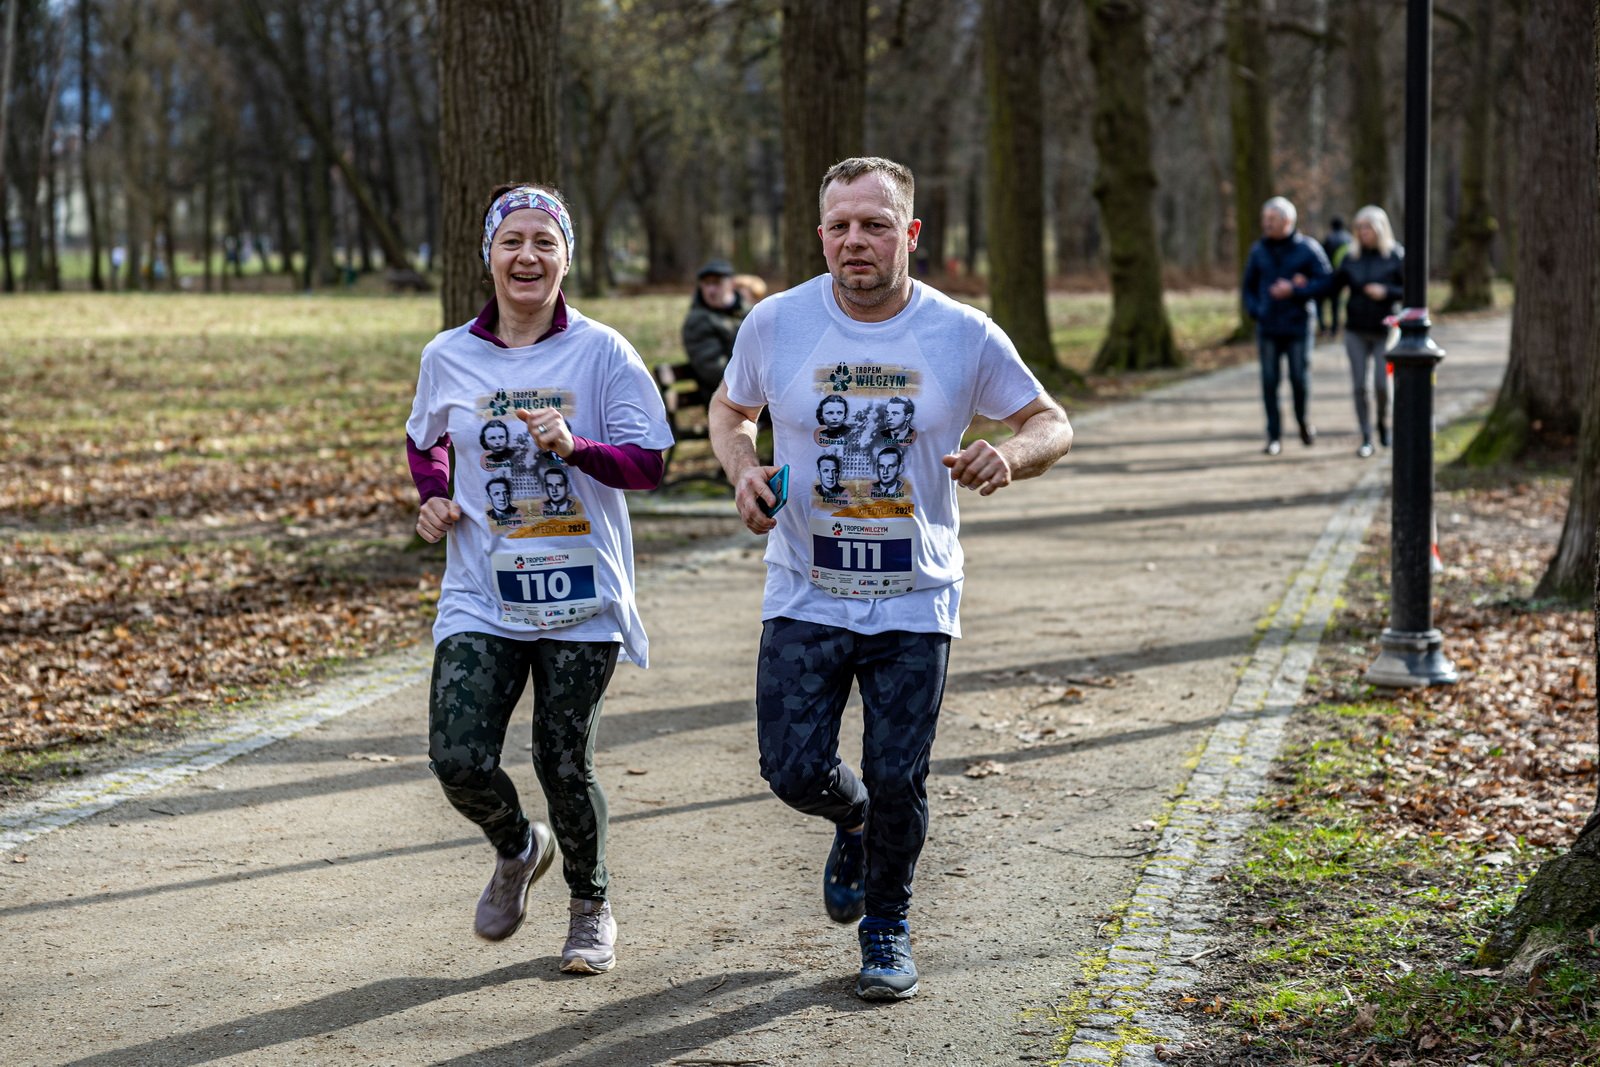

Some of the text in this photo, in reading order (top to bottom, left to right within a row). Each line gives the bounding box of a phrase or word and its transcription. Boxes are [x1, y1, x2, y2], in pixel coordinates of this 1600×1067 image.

[856, 374, 906, 387] WILCZYM
[513, 397, 562, 410] WILCZYM
[822, 496, 848, 505] Kontrym
[567, 523, 587, 533] 2024
[837, 540, 882, 570] 111
[516, 570, 572, 600] 110
